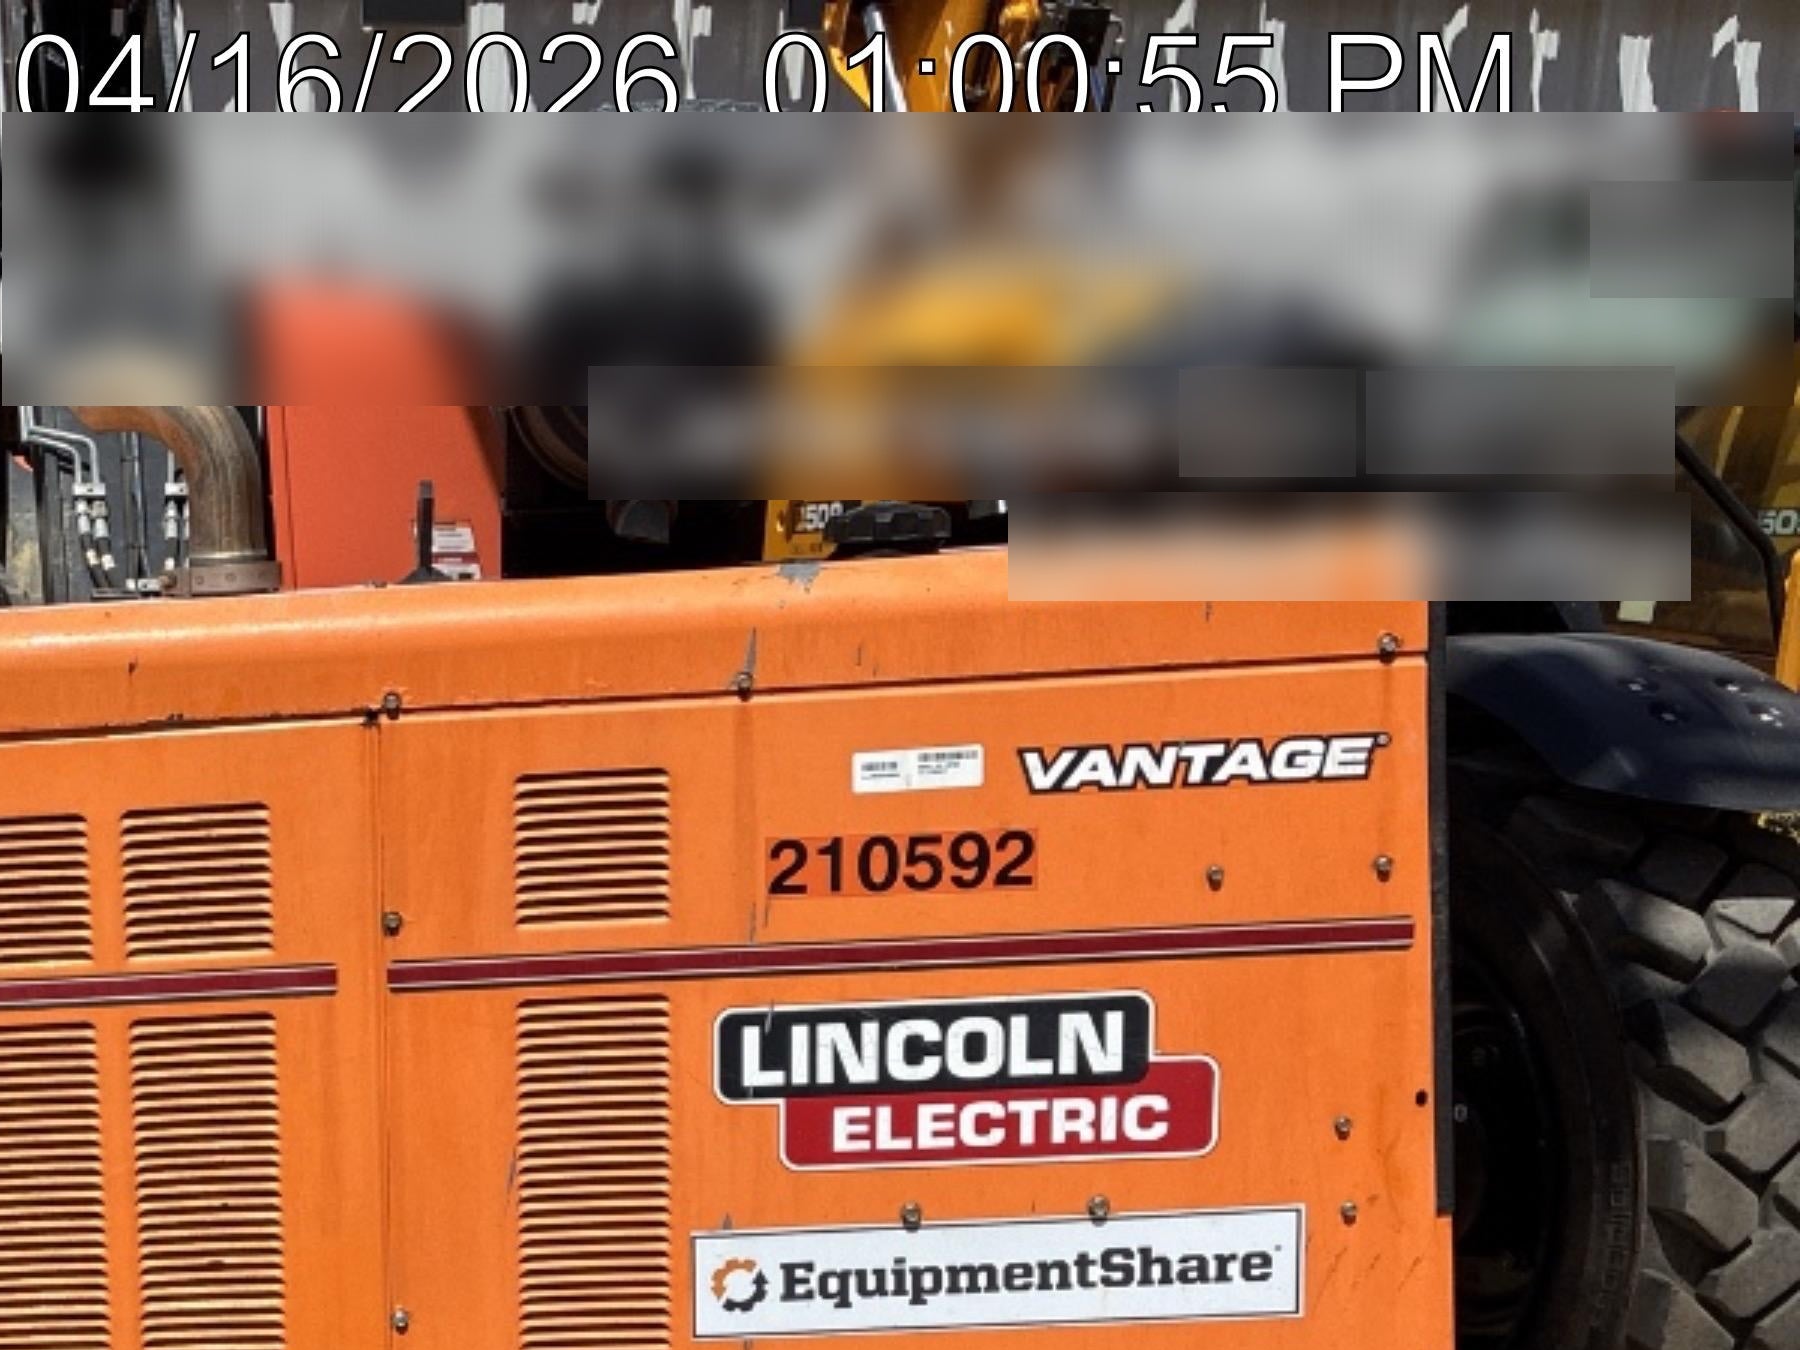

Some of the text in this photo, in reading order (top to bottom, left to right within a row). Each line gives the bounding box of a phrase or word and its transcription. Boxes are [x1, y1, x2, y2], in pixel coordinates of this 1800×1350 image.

[1022, 736, 1373, 792] VANTAGE
[768, 830, 1034, 895] 210592
[741, 1009, 1125, 1088] LINCOLN
[831, 1096, 1170, 1154] ELECTRIC
[779, 1243, 1276, 1309] EquipmentShare
